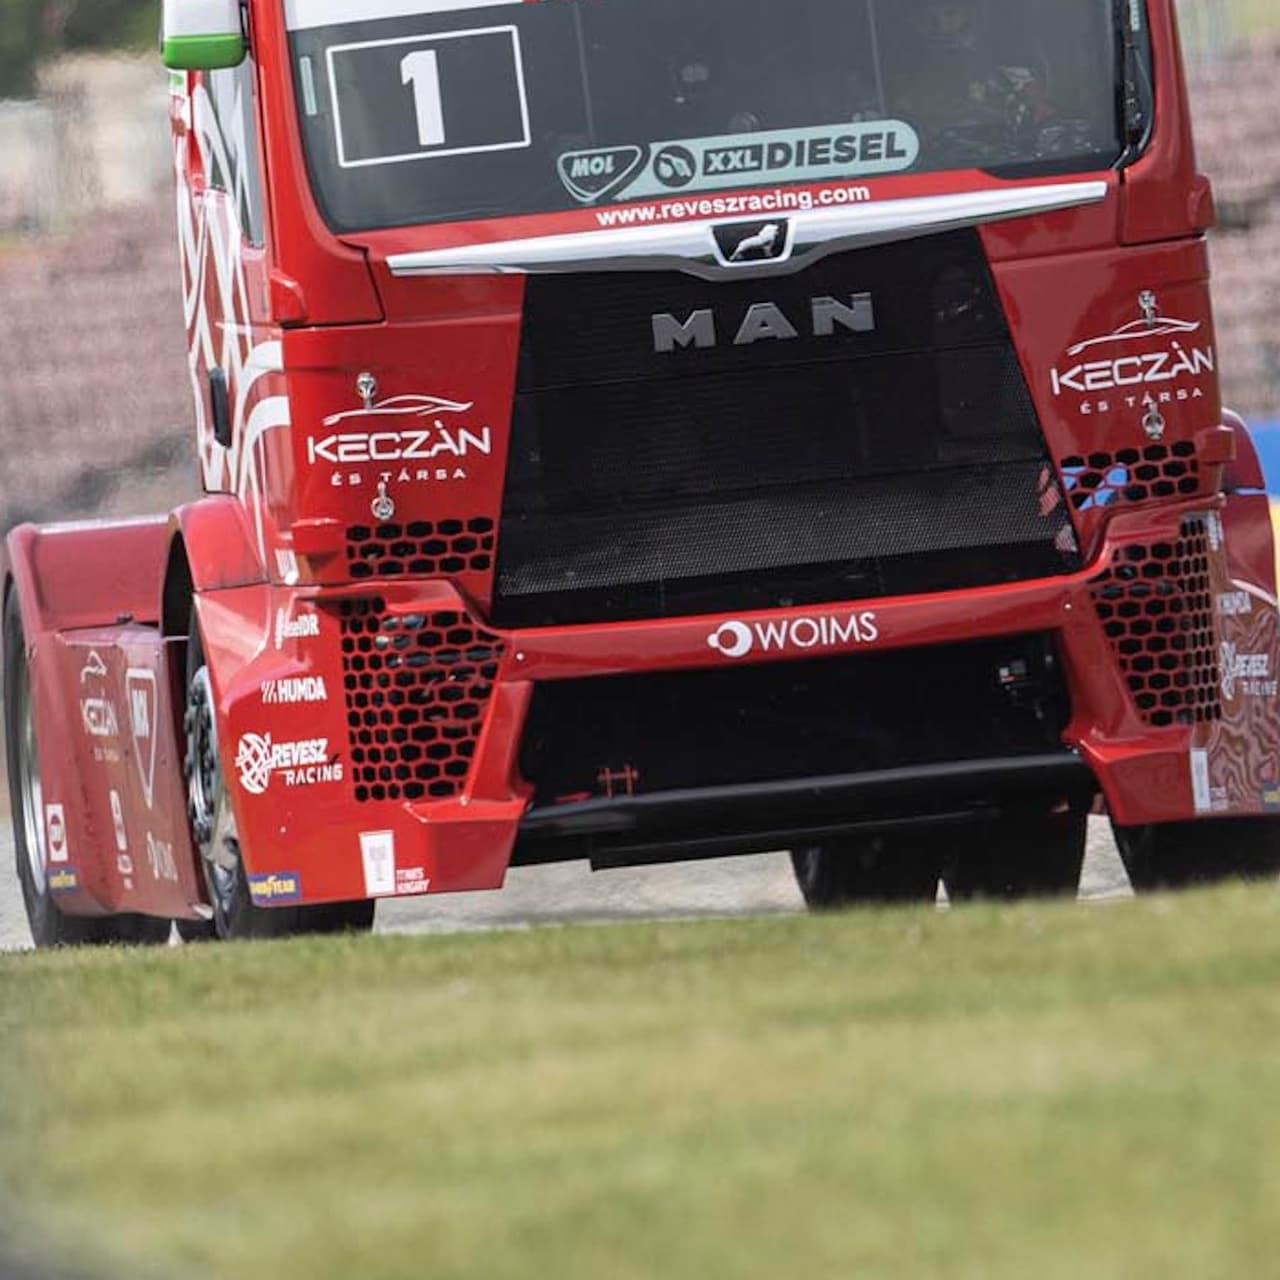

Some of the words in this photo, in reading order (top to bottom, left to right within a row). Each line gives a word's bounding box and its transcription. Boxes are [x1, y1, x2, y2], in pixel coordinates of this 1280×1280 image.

[401, 49, 445, 145] 1
[570, 154, 616, 178] MOL
[706, 146, 761, 174] XXL
[765, 131, 907, 170] DIESEL
[595, 183, 871, 226] www.reveszracing.com
[652, 292, 876, 352] MAN
[754, 611, 878, 651] WOIMS
[286, 763, 343, 786] RACING
